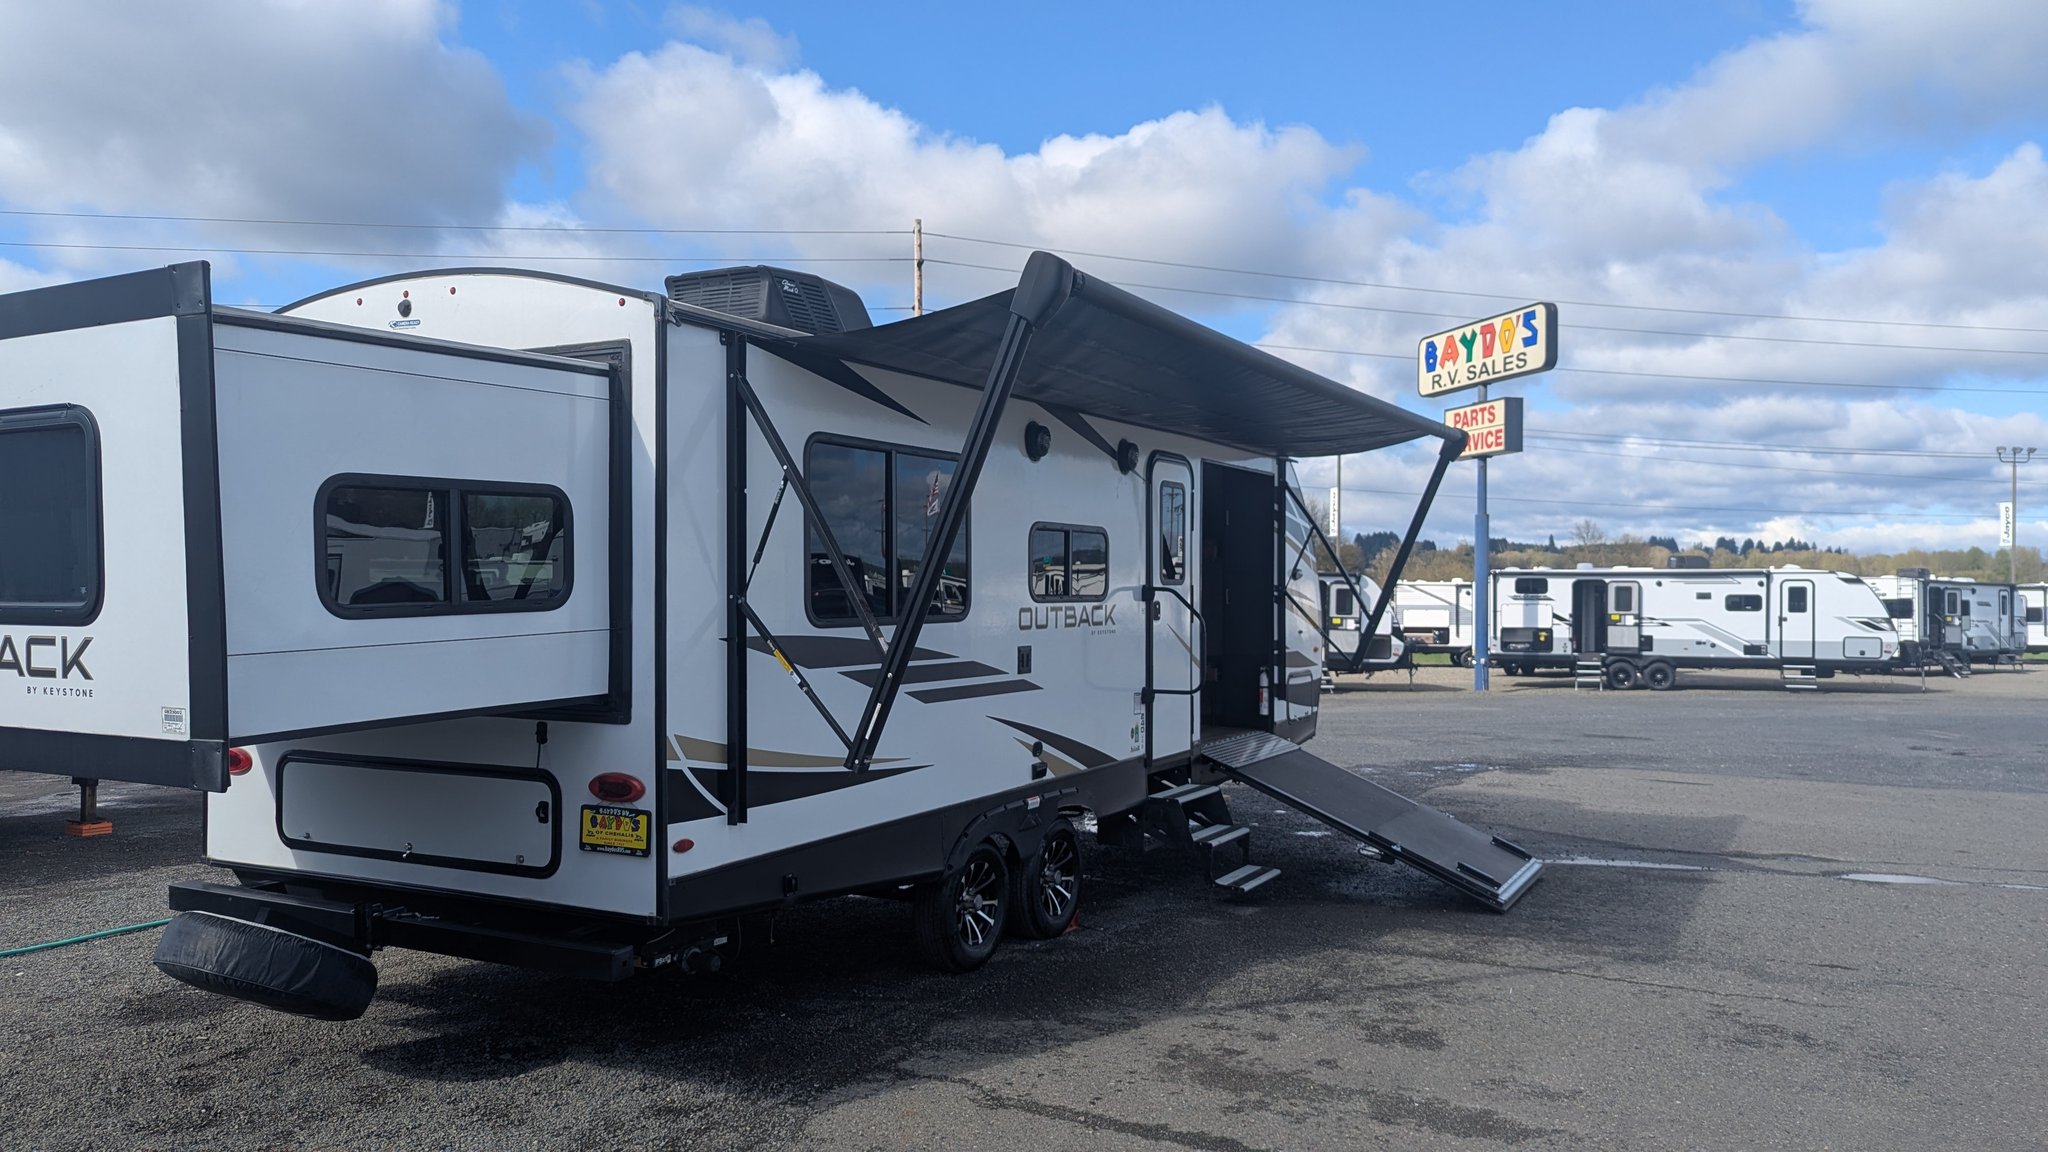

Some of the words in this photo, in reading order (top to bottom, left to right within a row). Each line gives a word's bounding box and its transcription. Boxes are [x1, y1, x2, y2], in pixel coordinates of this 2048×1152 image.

[1424, 309, 1538, 373] BAYDO'S
[1431, 368, 1461, 390] R.V.
[1466, 352, 1527, 381] SALES
[1453, 404, 1496, 428] PARTS
[1463, 428, 1503, 452] RVICE
[1018, 604, 1117, 630] OUTBACK
[26, 685, 38, 695] BY
[43, 686, 94, 698] KEYSTONE
